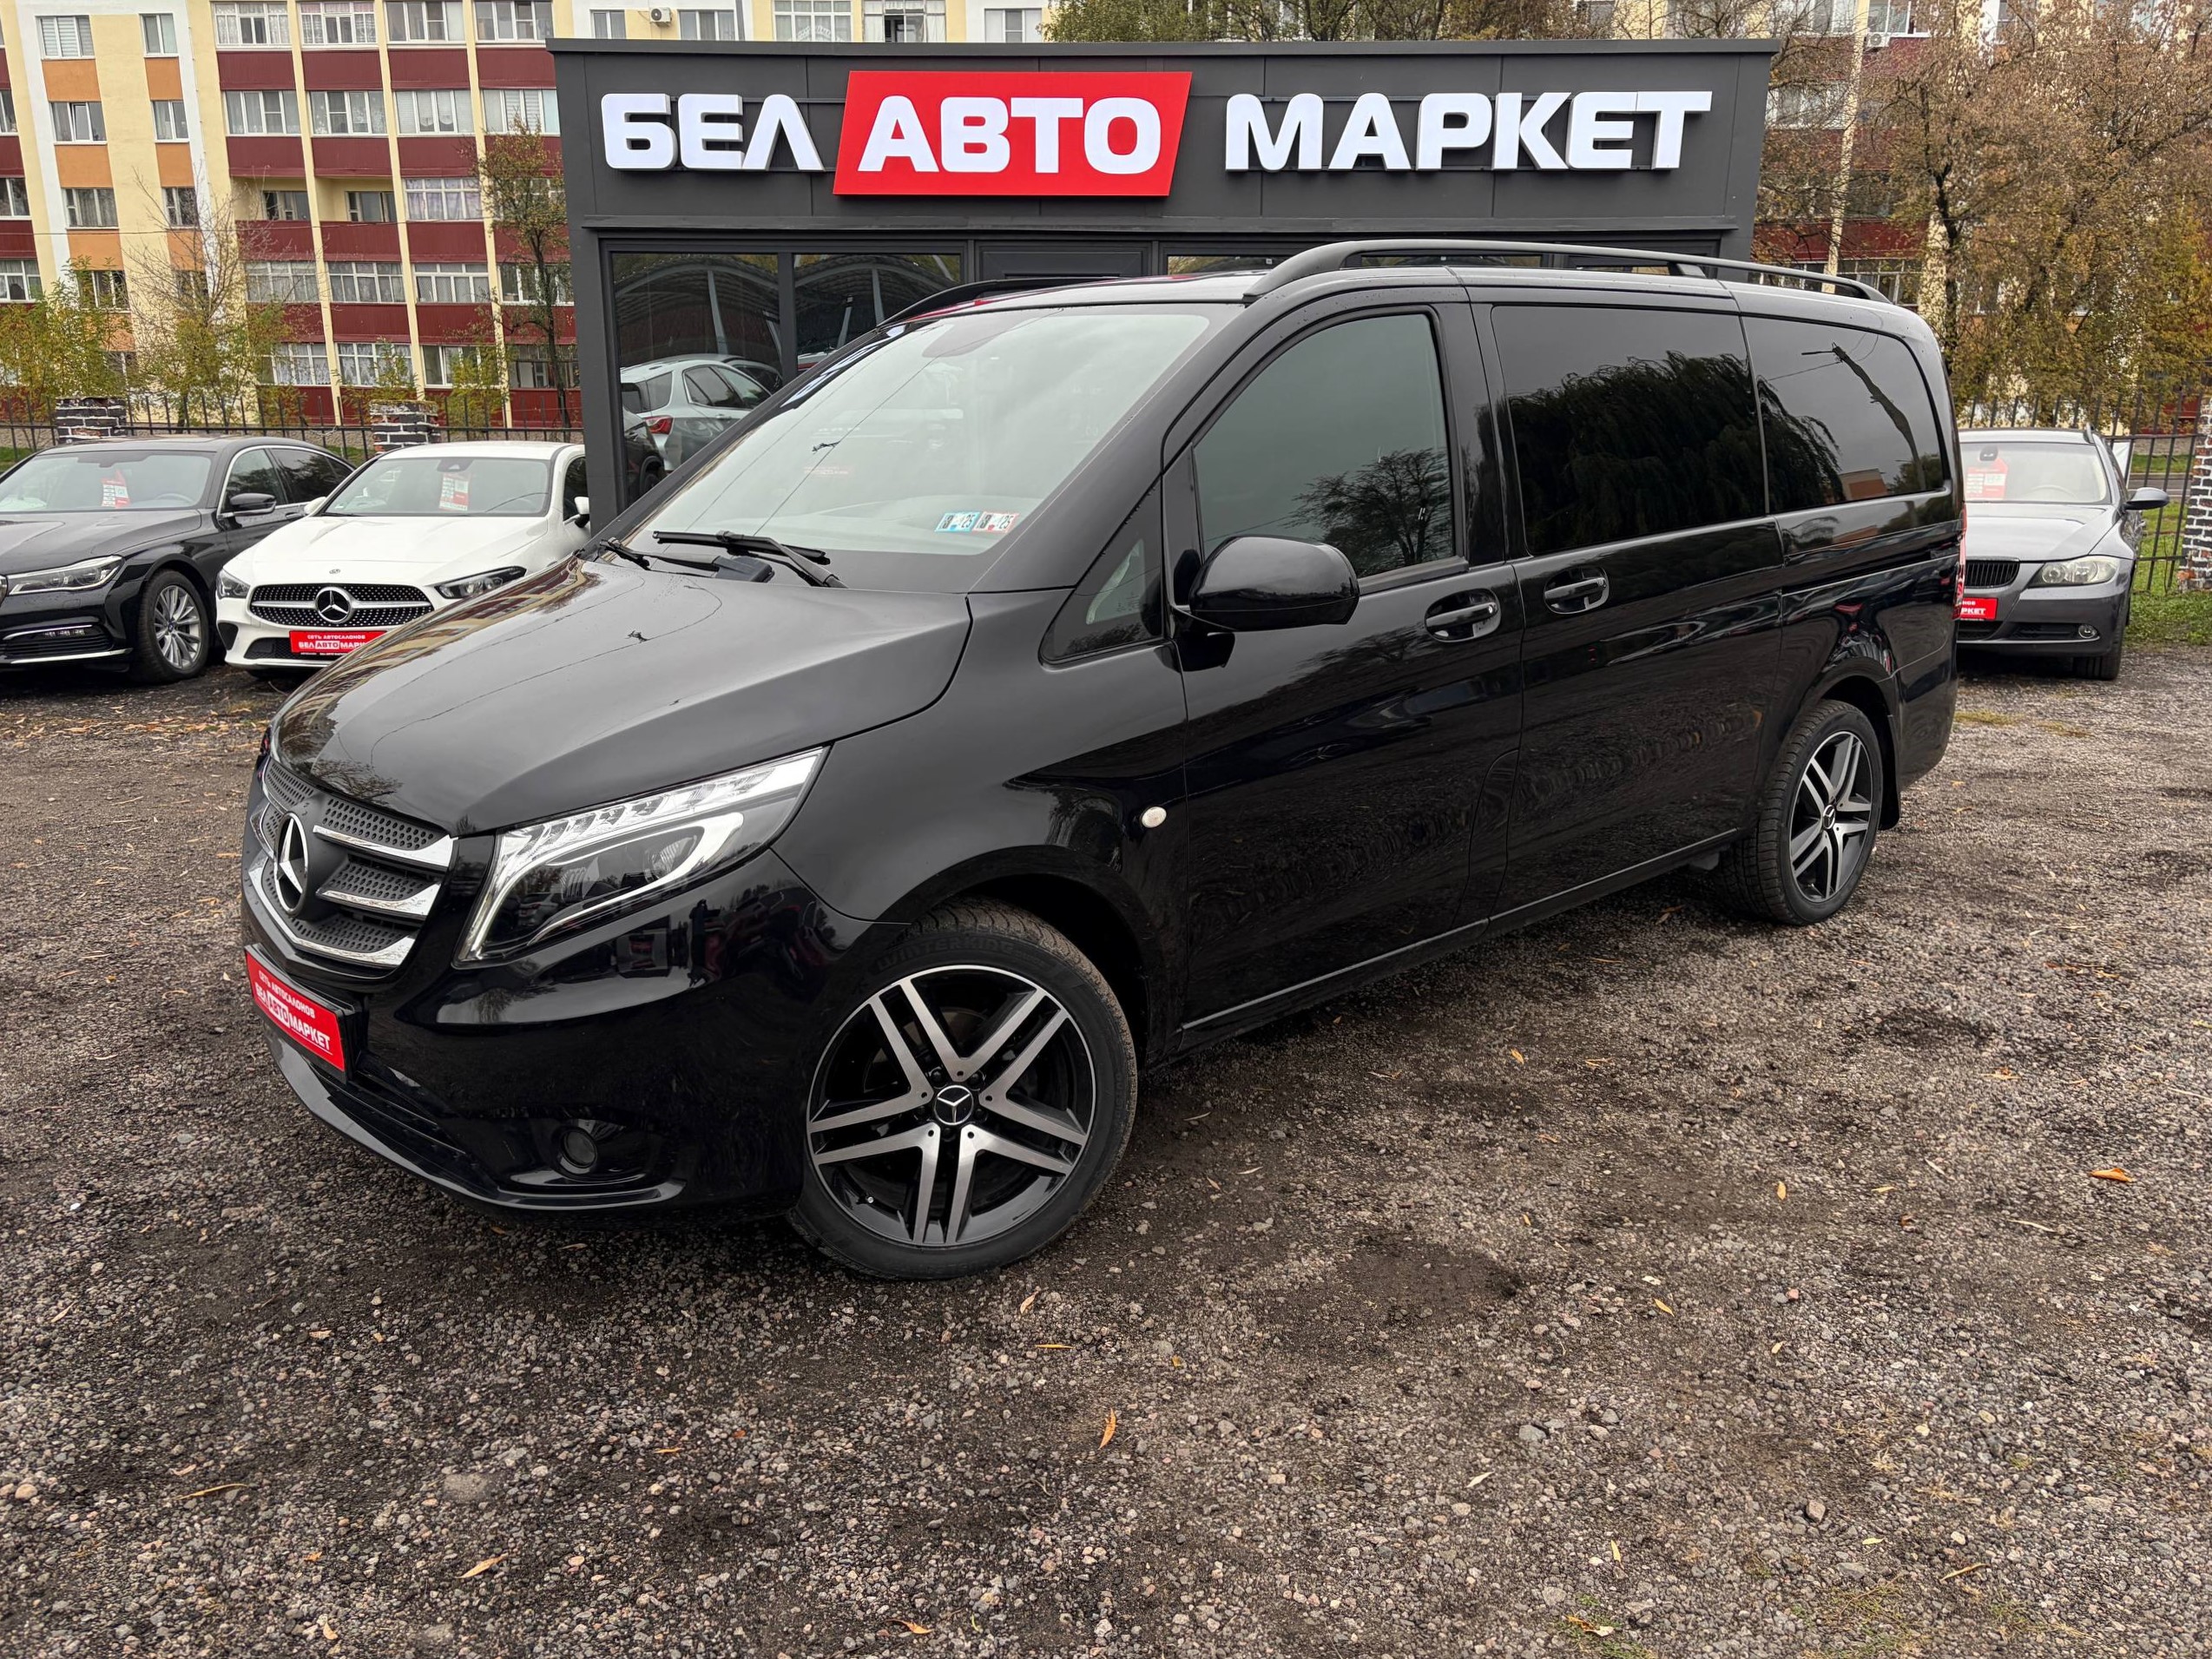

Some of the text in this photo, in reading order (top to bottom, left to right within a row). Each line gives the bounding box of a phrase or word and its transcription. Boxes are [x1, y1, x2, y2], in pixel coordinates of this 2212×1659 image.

[600, 90, 1713, 174] БЕЛ АВТО МАРКЕТ
[288, 1012, 331, 1050] МАРКЕТ
